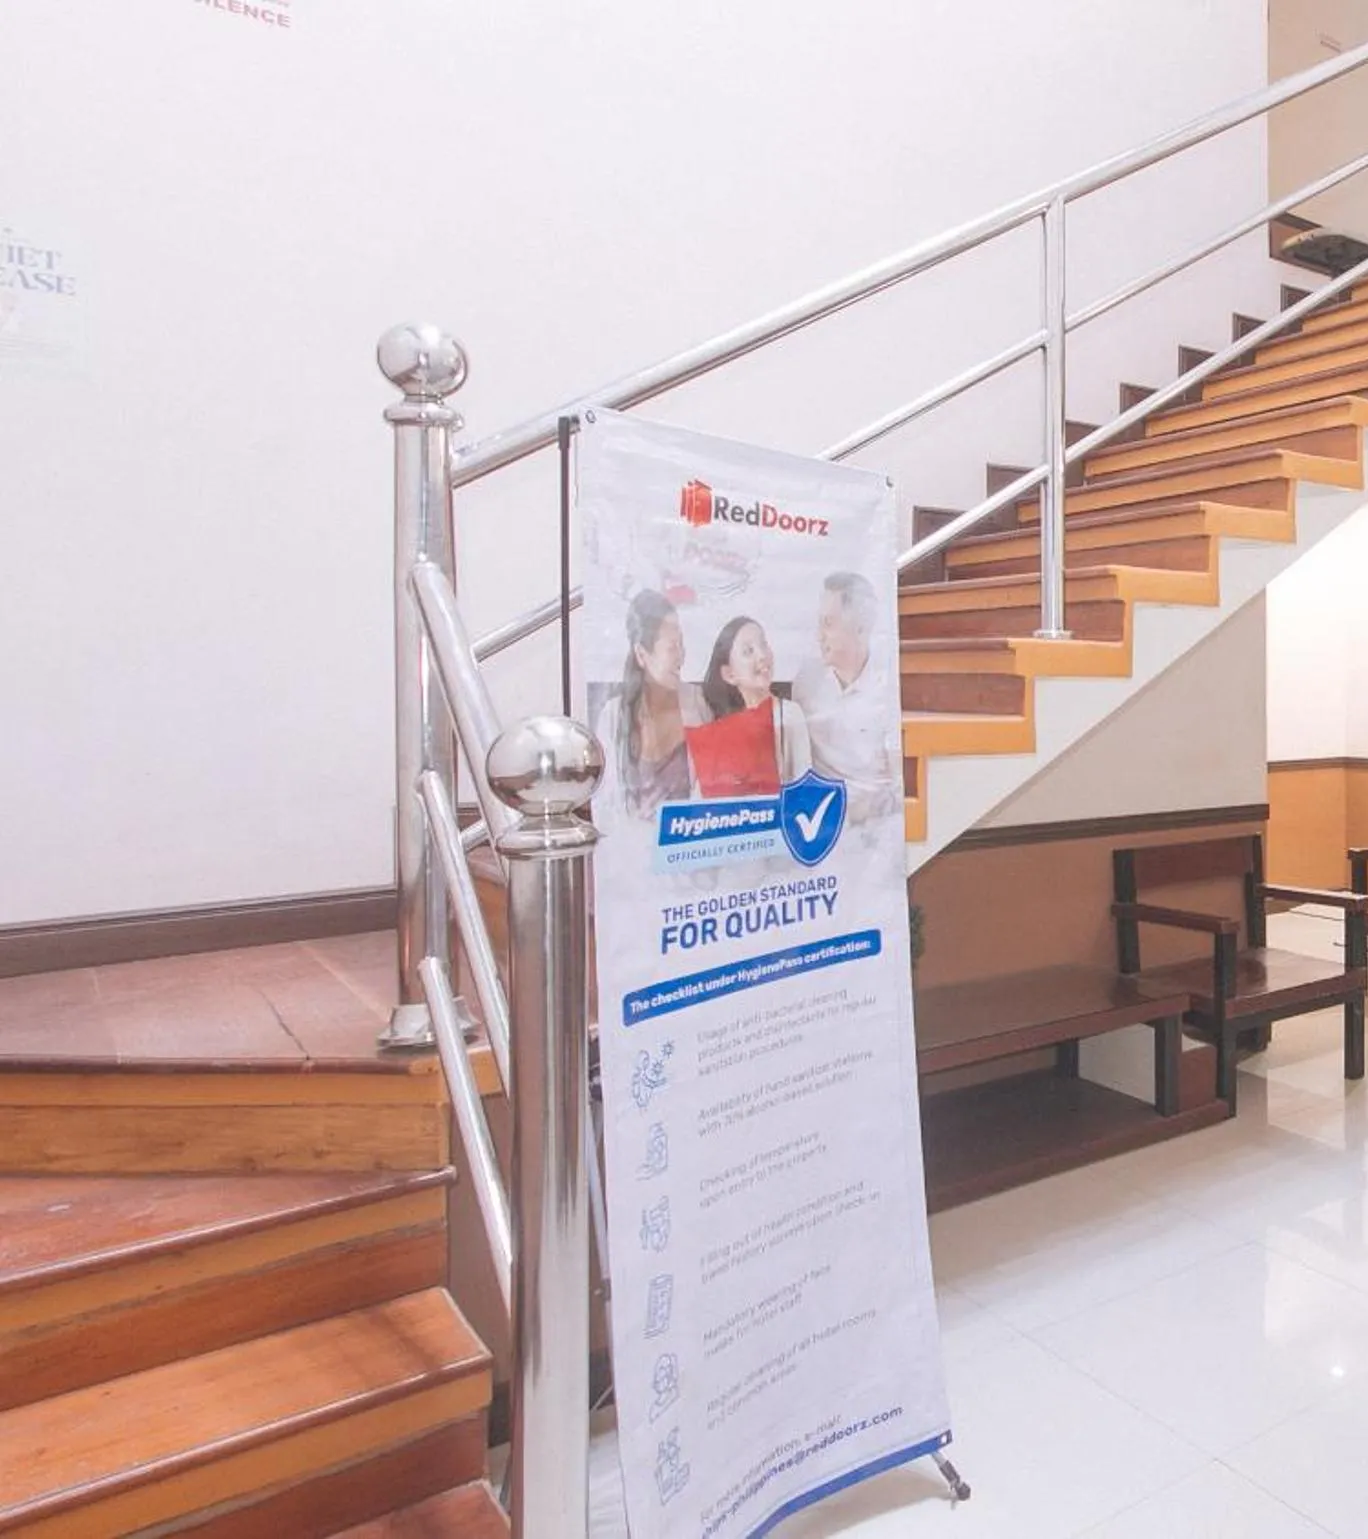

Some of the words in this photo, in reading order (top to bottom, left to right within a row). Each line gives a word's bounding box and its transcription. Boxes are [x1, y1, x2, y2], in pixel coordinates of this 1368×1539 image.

[194, 0, 292, 28] LENCE
[714, 496, 829, 537] RedDoorz
[670, 807, 776, 837] HygienePass
[667, 847, 724, 863] OFFICIALLY
[727, 839, 775, 854] CERTIFIED
[662, 903, 694, 923] THE
[698, 892, 757, 916] GOLDEN
[760, 876, 837, 901] STANDARD
[661, 918, 718, 955] FOR
[725, 891, 838, 938] QUALITY
[630, 999, 650, 1015] The
[651, 983, 705, 1008] checklist
[705, 974, 736, 990] under
[738, 956, 803, 982] HygienePass
